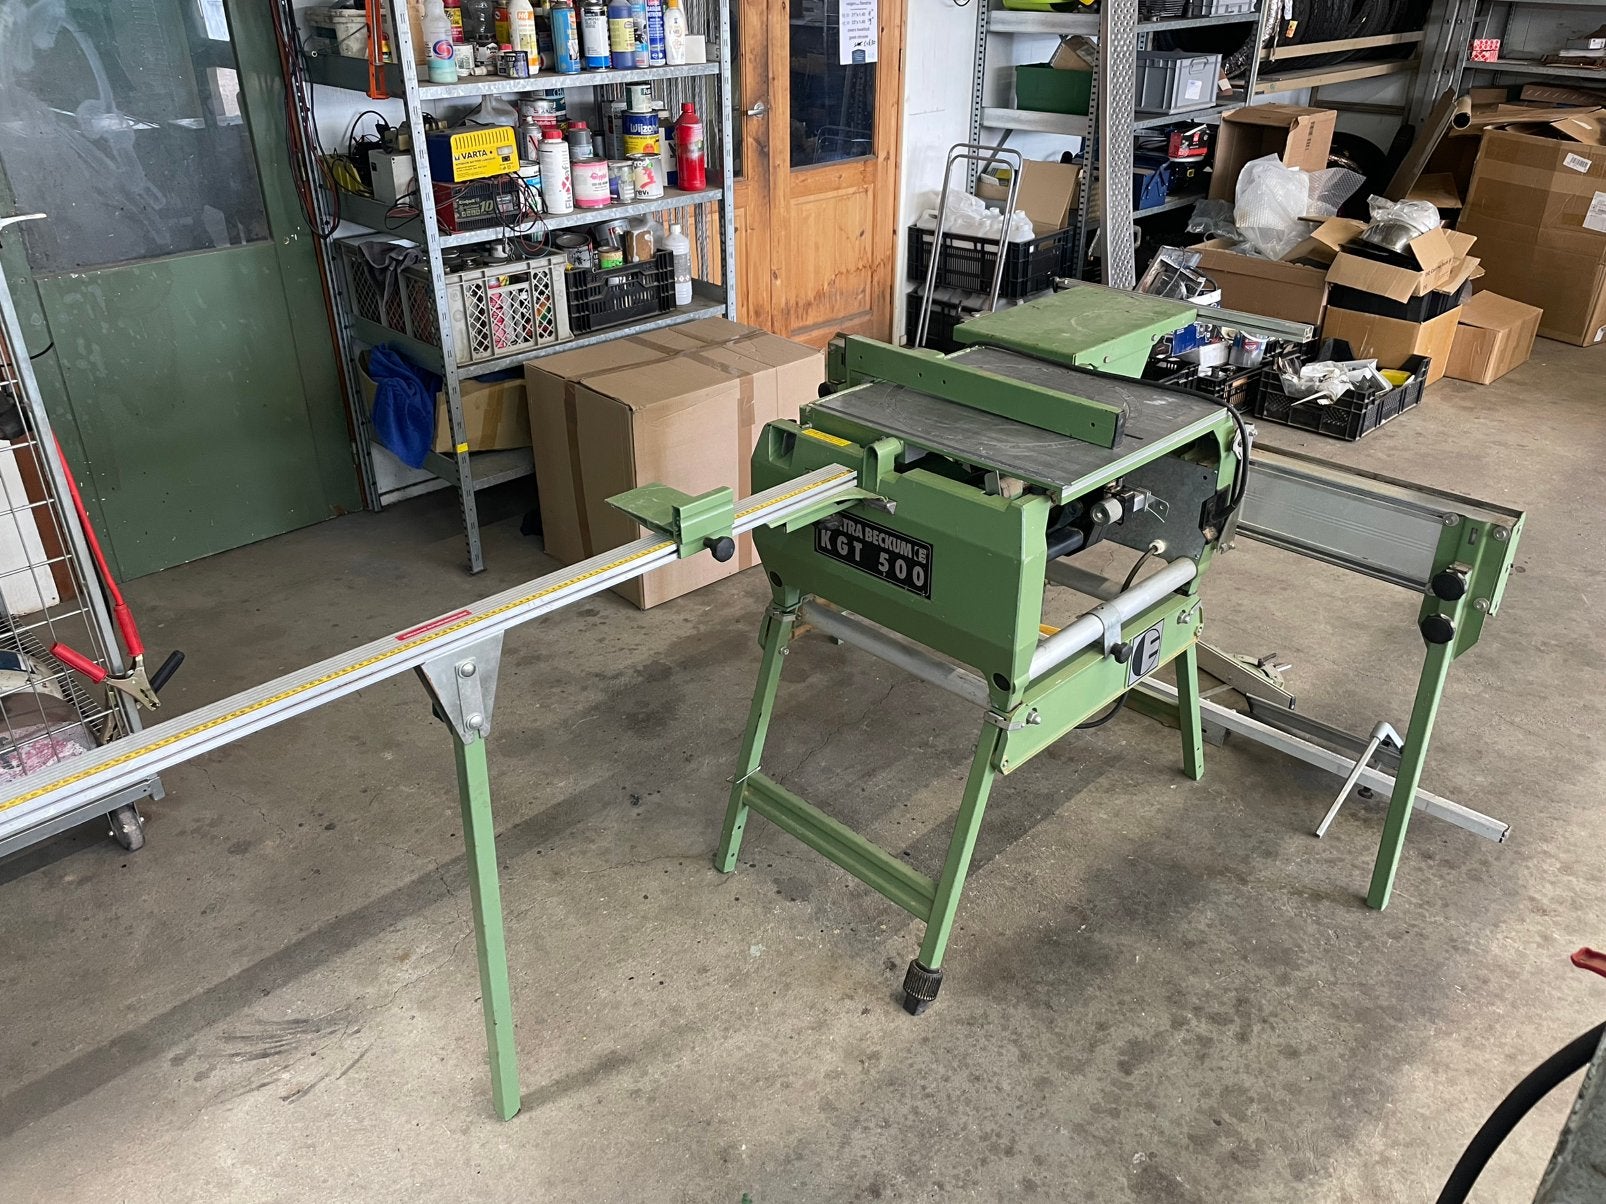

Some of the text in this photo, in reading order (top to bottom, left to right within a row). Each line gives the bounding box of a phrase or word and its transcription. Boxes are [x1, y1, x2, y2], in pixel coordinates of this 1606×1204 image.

[461, 149, 487, 160] VARTA
[480, 199, 493, 212] 10
[864, 526, 913, 559] BECKUM
[820, 529, 925, 587] KGT 500
